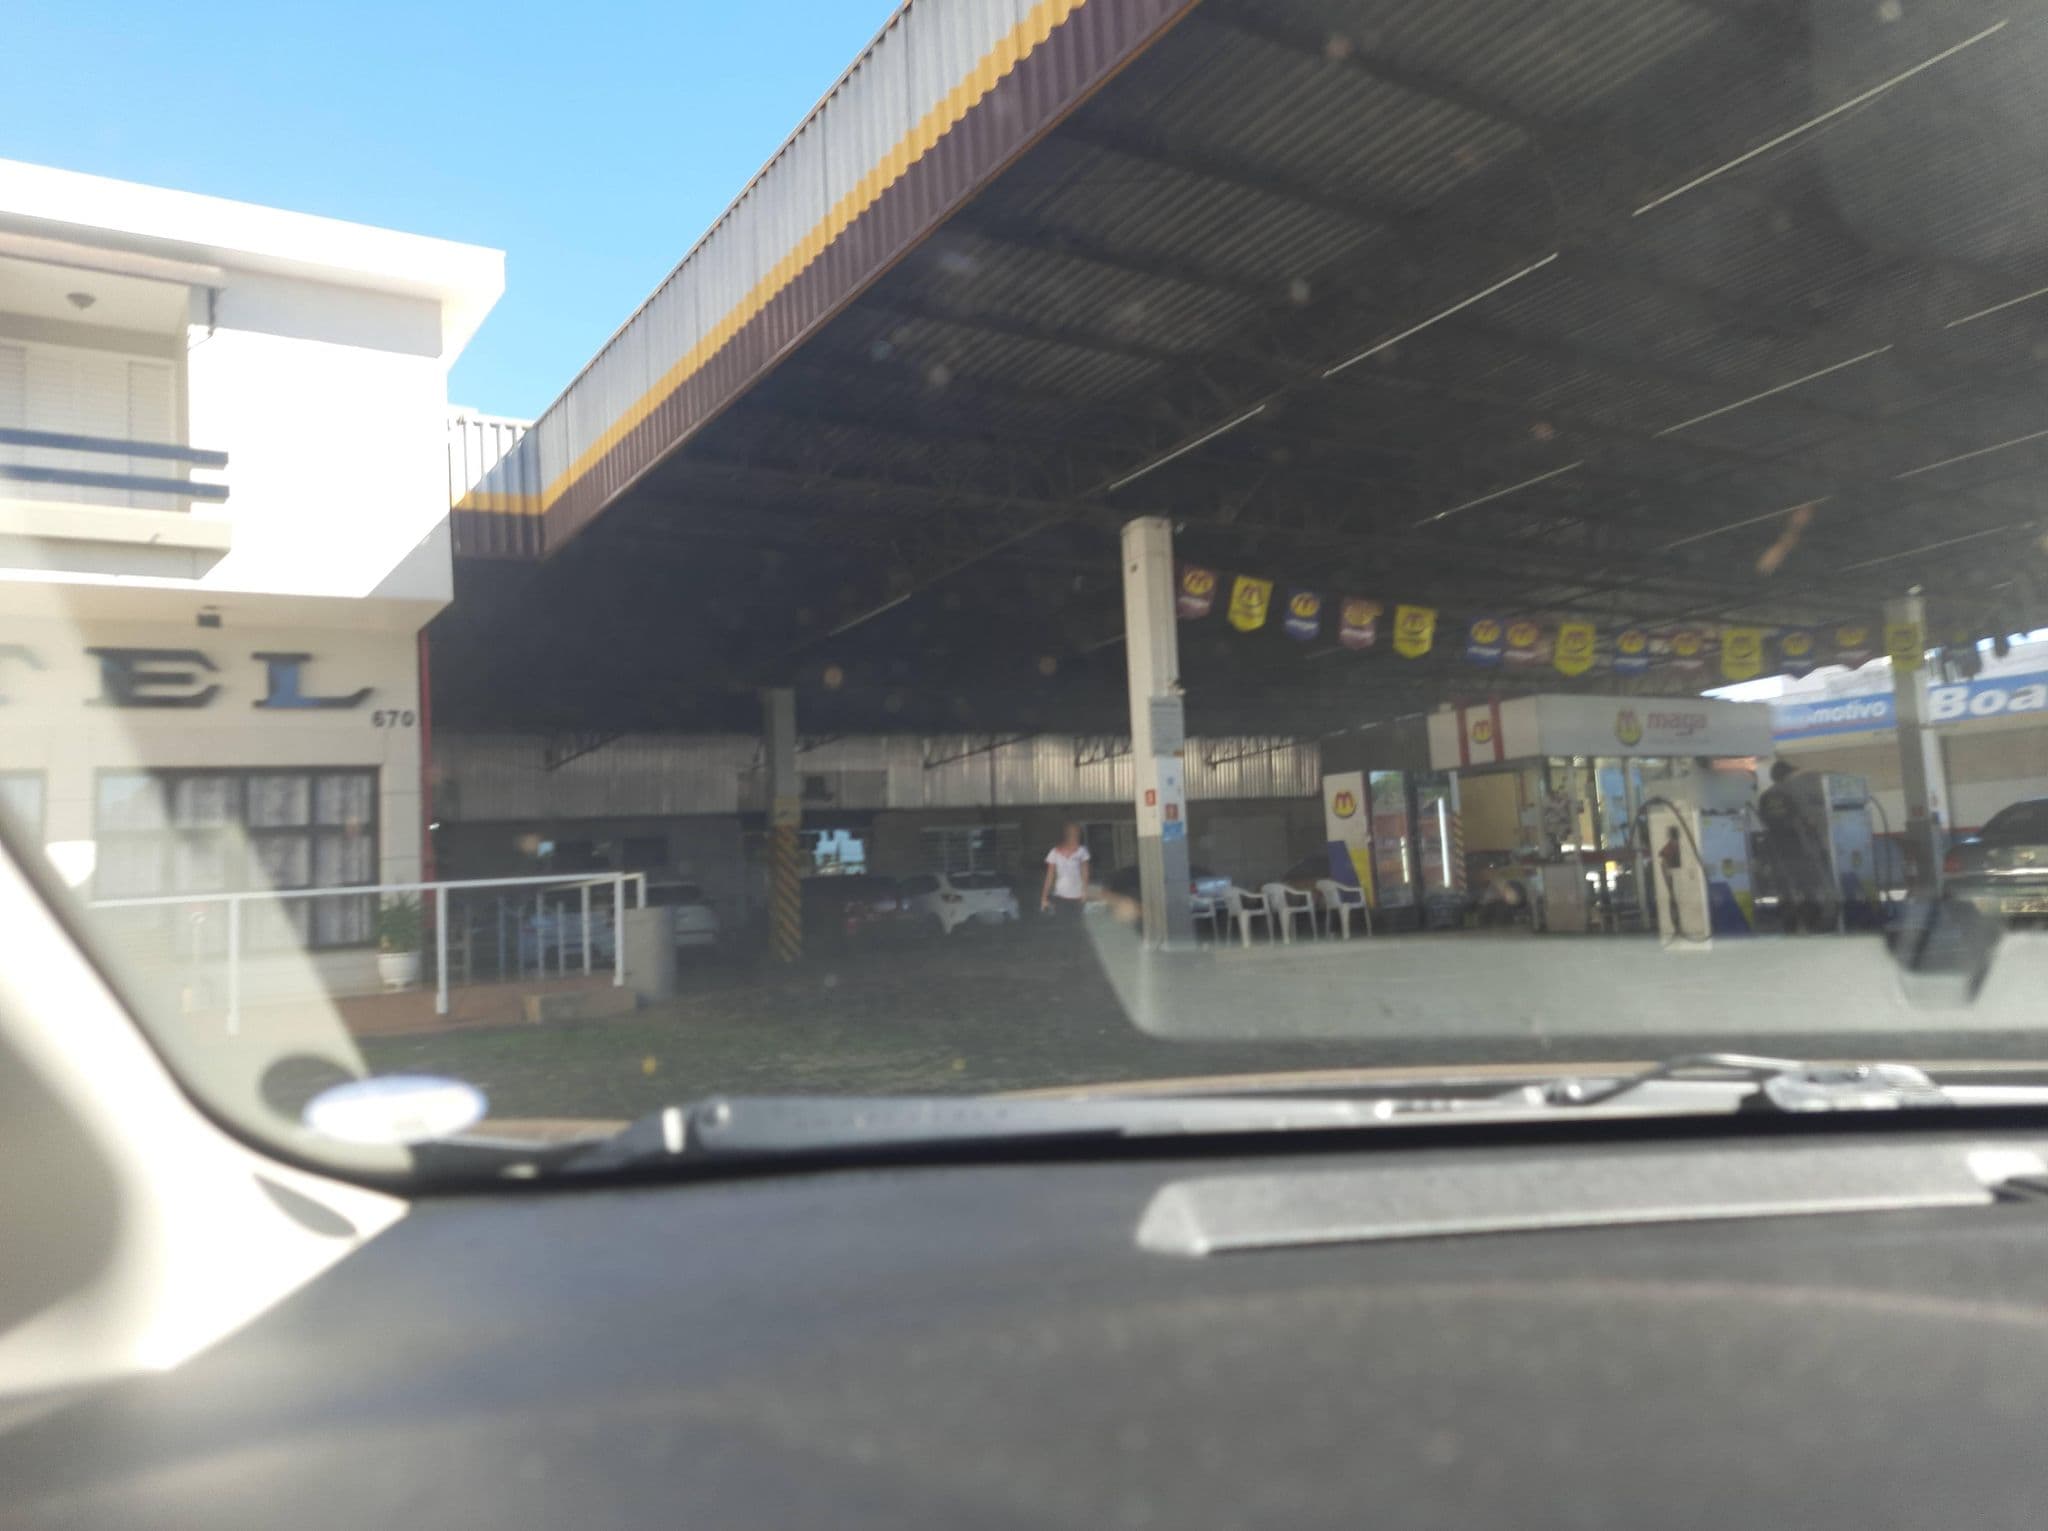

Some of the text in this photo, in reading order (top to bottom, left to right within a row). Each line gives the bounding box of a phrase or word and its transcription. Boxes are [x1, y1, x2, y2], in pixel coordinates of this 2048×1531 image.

[1781, 700, 1887, 727] motivo
[1926, 683, 2048, 721] Boa
[371, 709, 416, 728] 670
